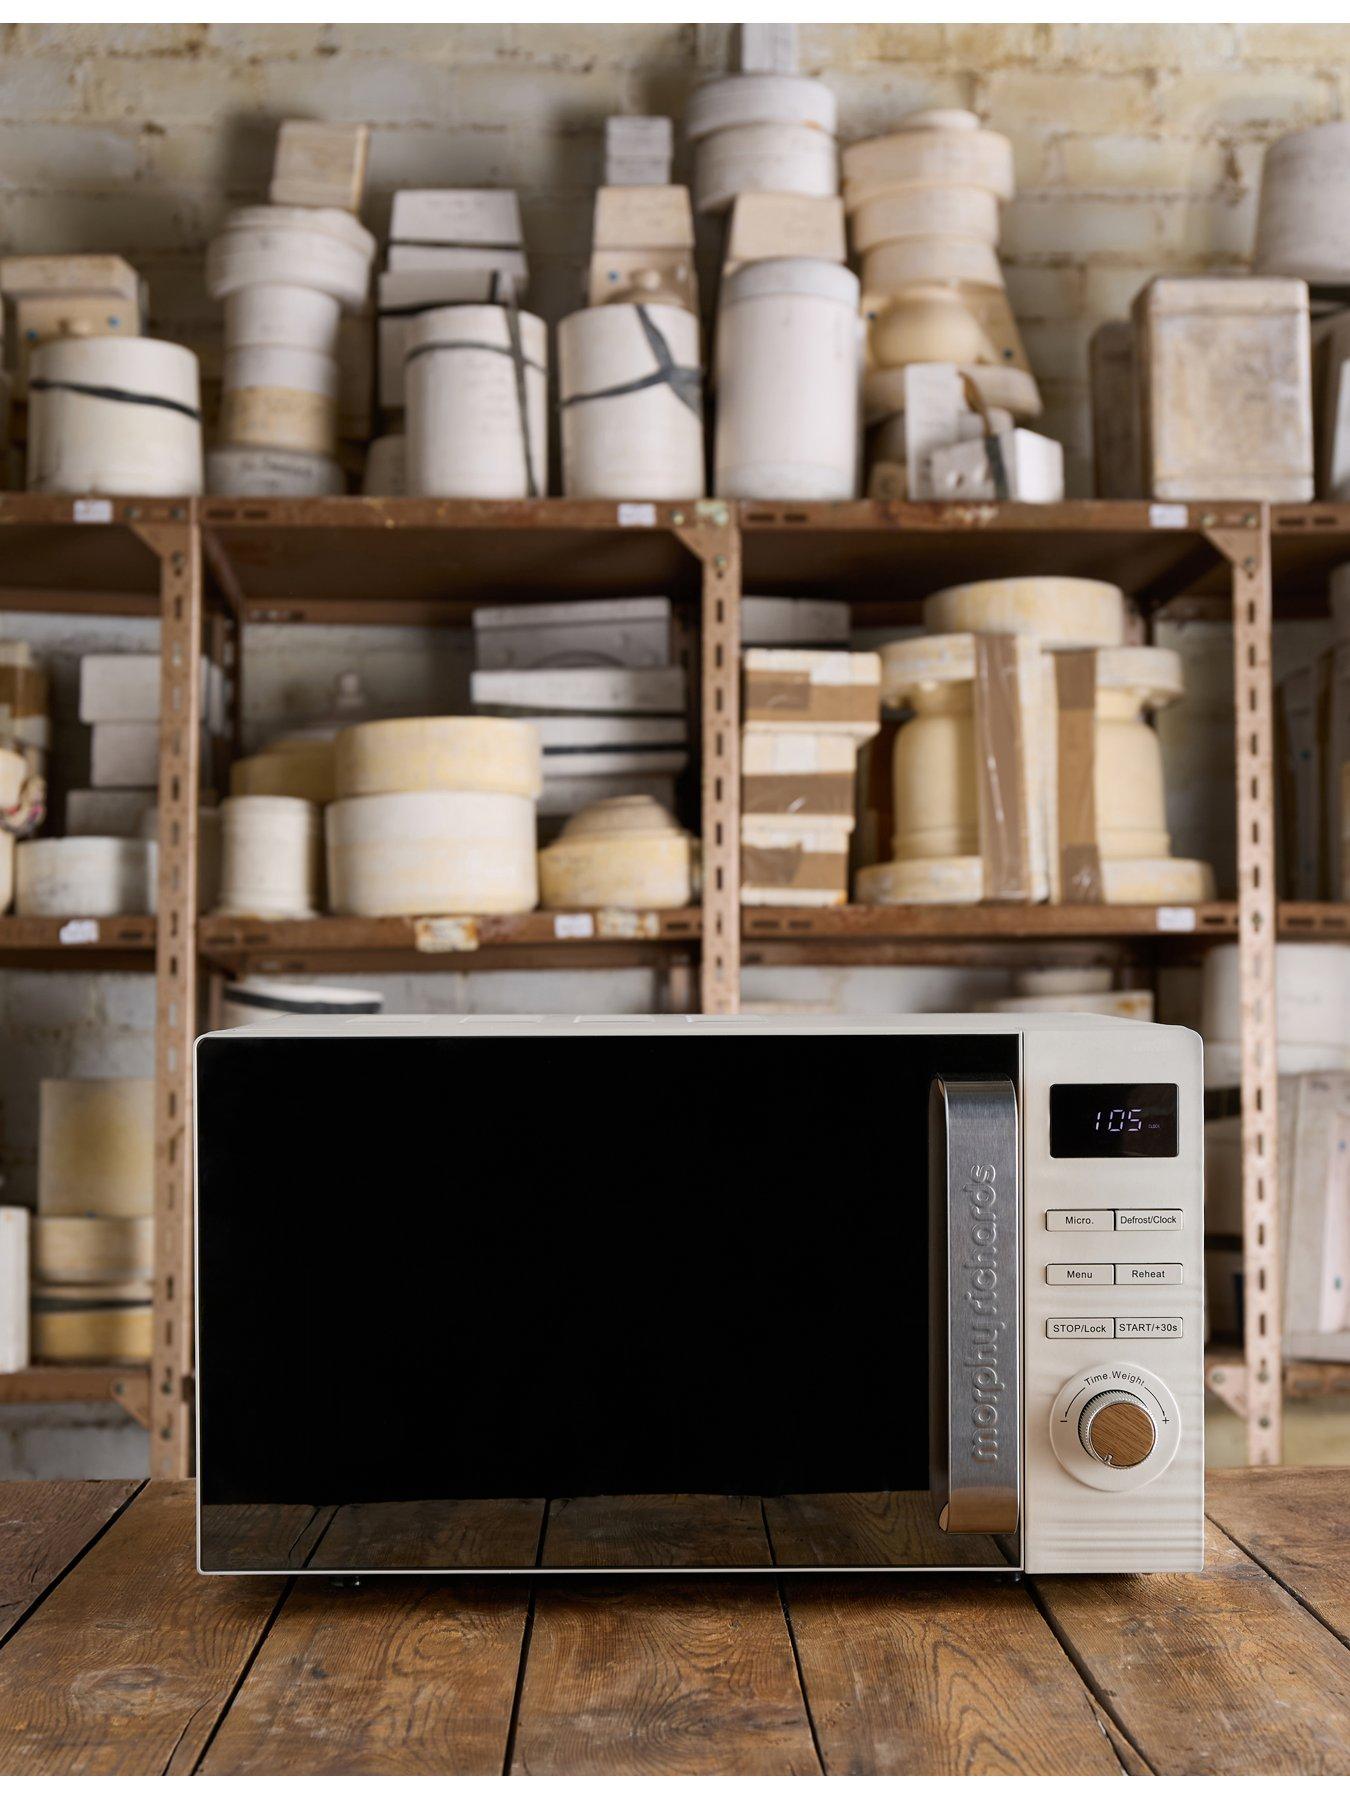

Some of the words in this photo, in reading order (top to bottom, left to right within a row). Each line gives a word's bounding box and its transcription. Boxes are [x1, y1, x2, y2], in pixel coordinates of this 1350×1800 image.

[1065, 1216, 1094, 1225] Micro.
[1120, 1215, 1177, 1225] Defrost/Clock
[963, 1164, 997, 1316] richards
[1066, 1270, 1093, 1279] Menu
[1131, 1269, 1165, 1278] Reheat
[1053, 1324, 1107, 1333] STOP/Lock
[1119, 1323, 1178, 1332] START/+30s
[963, 1321, 1006, 1464] morphy
